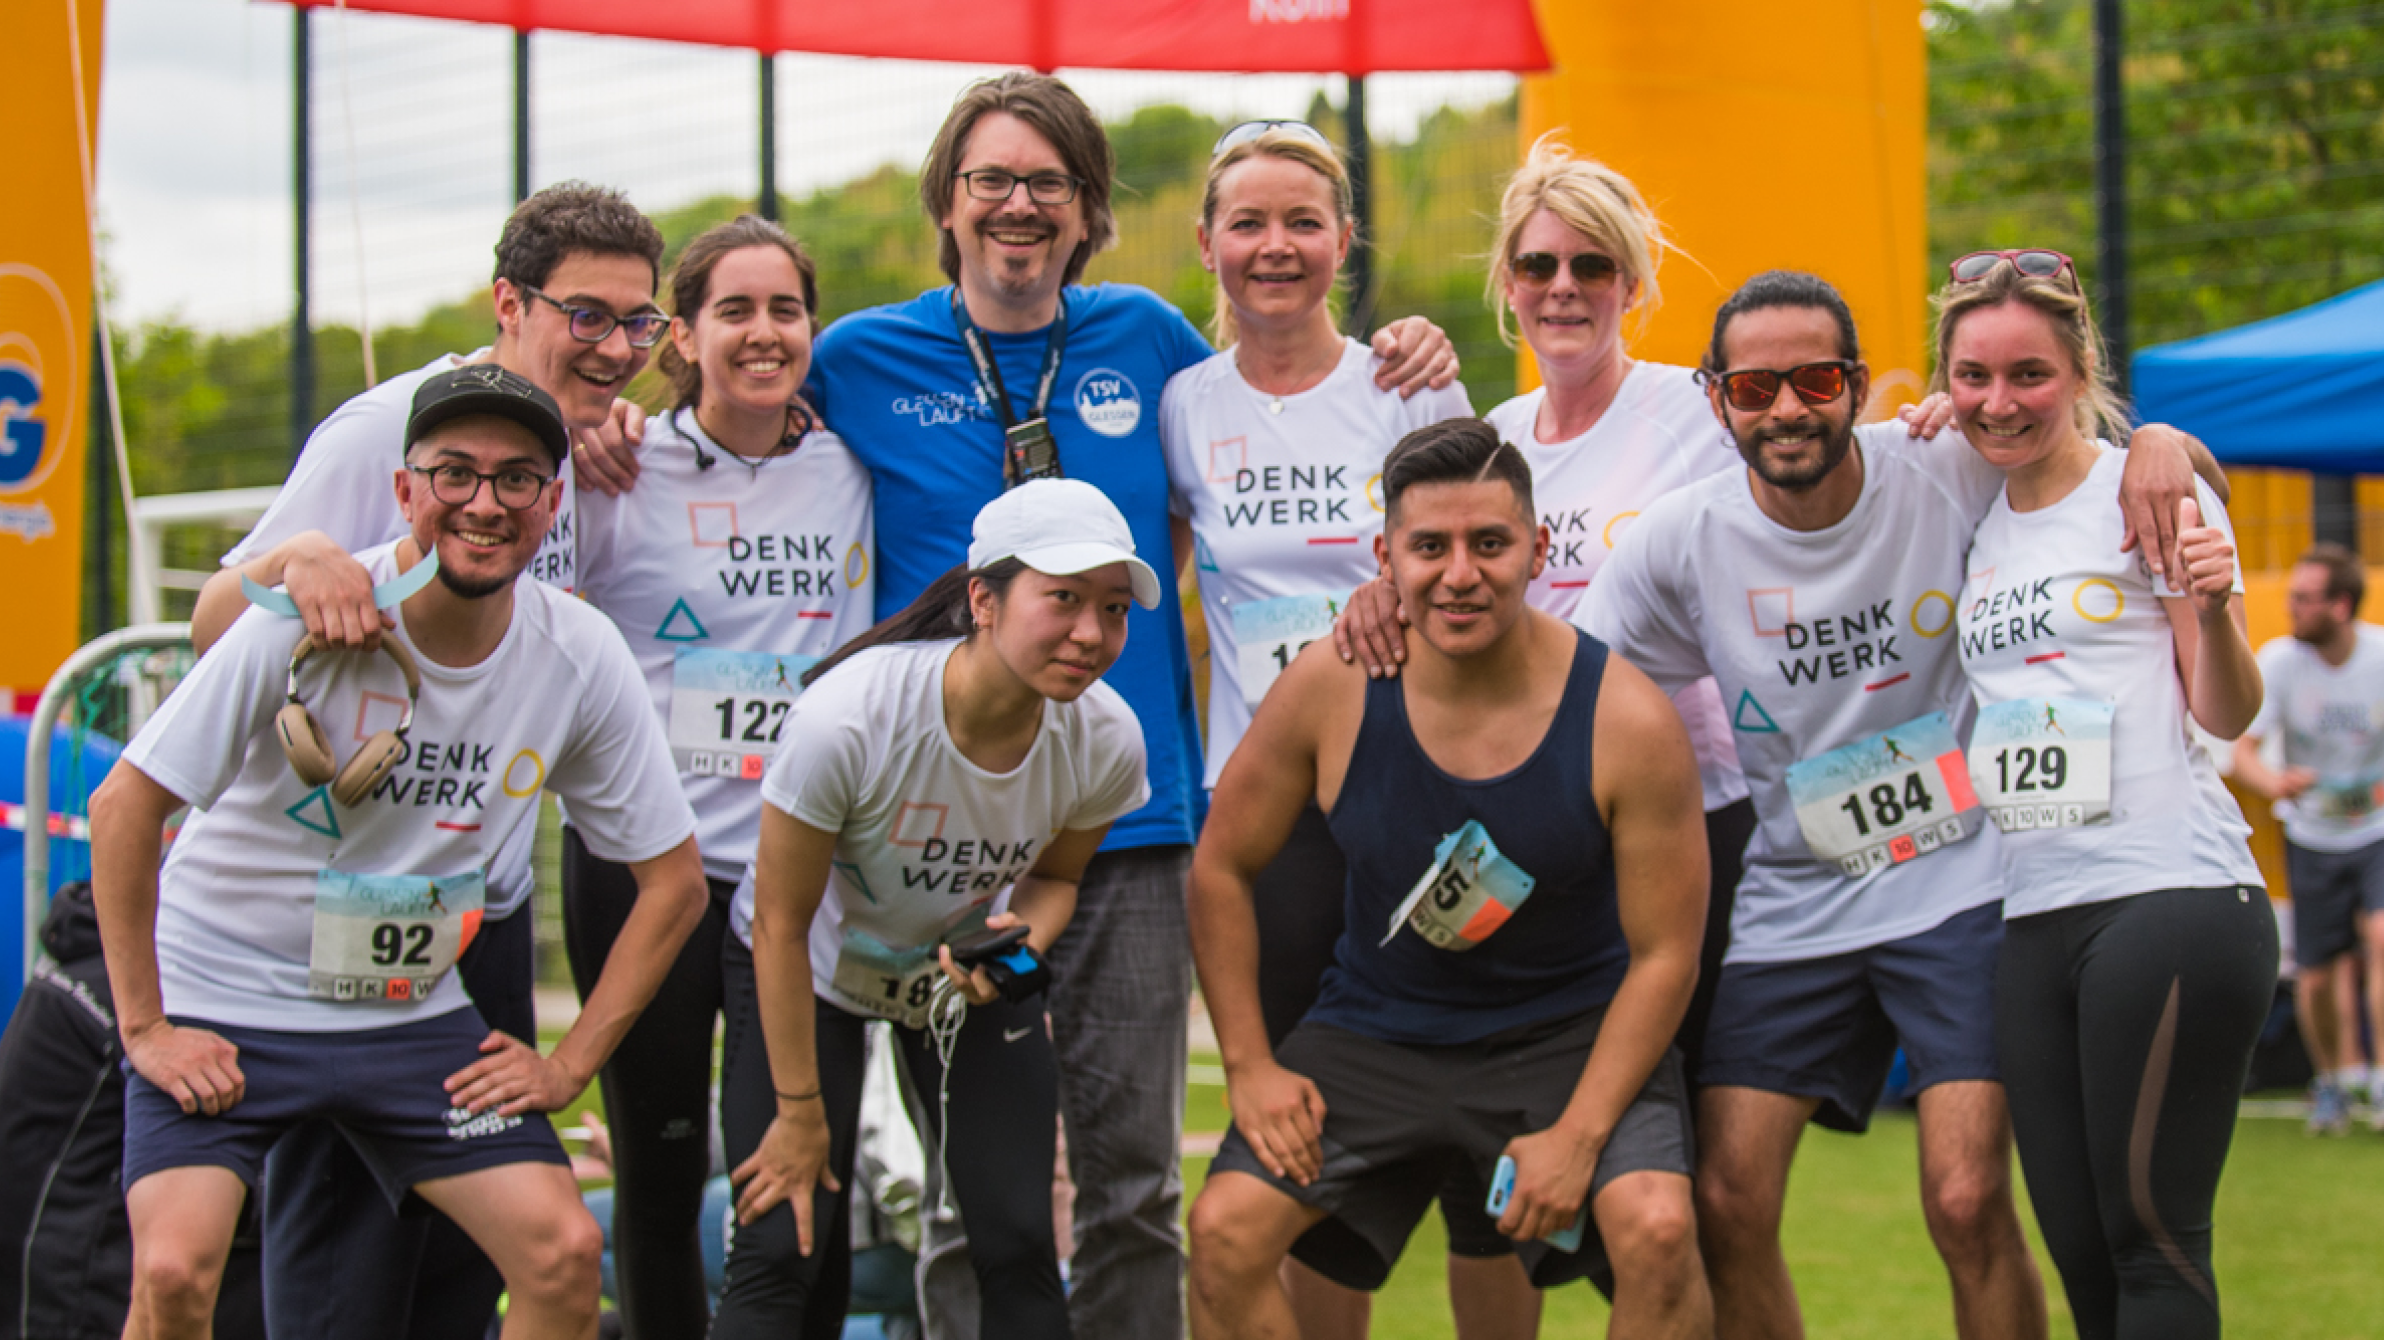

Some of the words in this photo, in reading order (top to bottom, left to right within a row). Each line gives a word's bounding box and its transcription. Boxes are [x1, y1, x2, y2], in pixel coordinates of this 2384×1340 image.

[1089, 380, 1121, 397] TSV
[1236, 465, 1349, 493] DENK
[543, 510, 573, 548] NK
[1224, 497, 1352, 528] WERK
[1543, 507, 1591, 534] NK
[527, 548, 573, 582] ERK
[728, 535, 834, 562] DENK
[1547, 540, 1584, 568] RK
[720, 570, 835, 598] WERK
[1972, 576, 2054, 621] DENK
[1785, 598, 1895, 650] DENK
[1962, 609, 2056, 659] WERK
[1779, 635, 1902, 686] WERK
[1995, 745, 2067, 793] 129
[372, 774, 486, 810] WERK
[1841, 771, 1933, 837] 184
[922, 838, 1036, 866] DENK
[903, 865, 1025, 895] WERK
[372, 923, 434, 966] 92
[880, 968, 948, 1009] 18
